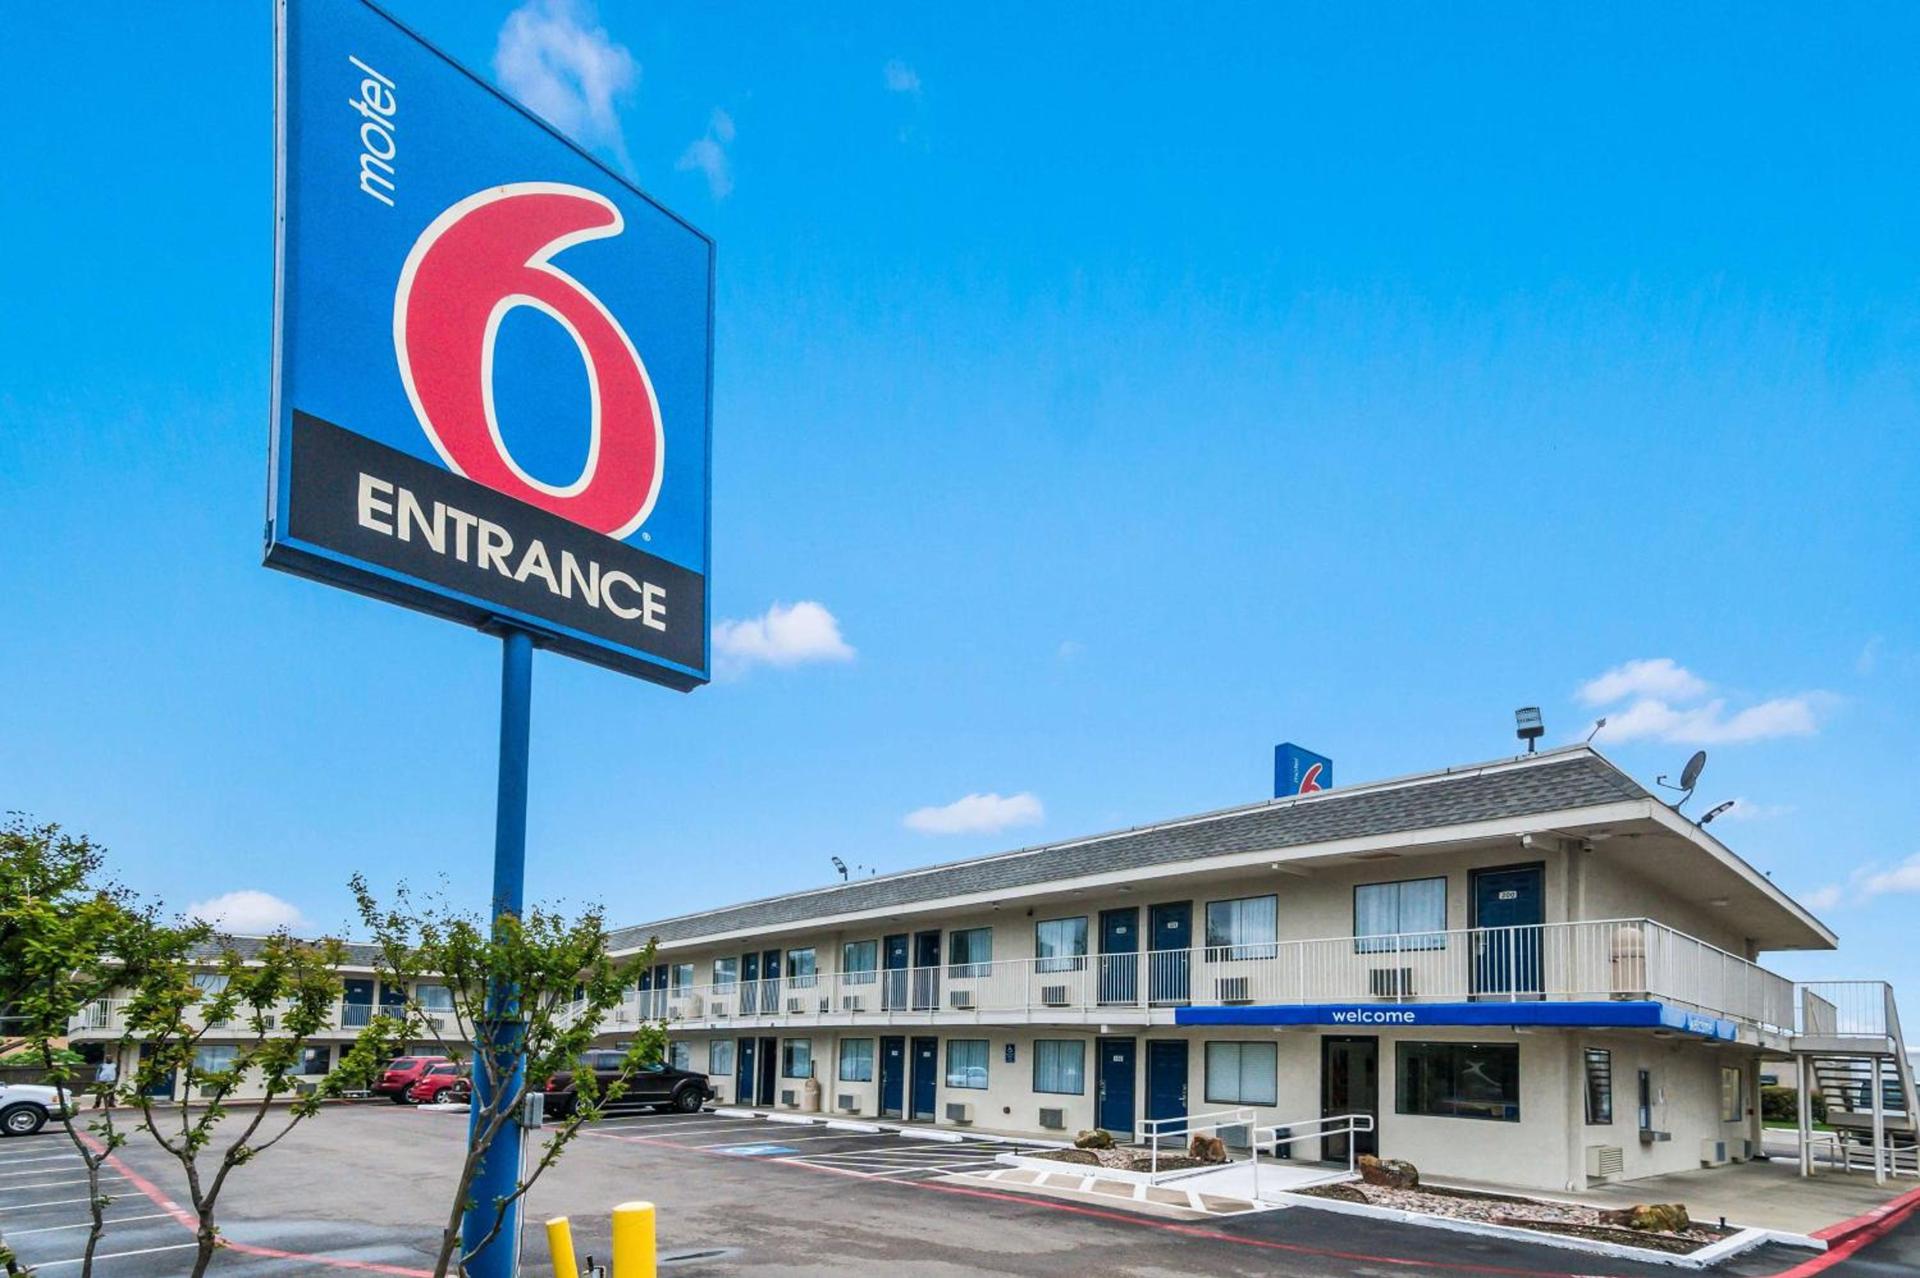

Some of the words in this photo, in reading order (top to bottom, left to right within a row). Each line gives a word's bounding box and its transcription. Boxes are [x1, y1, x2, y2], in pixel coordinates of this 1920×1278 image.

[348, 55, 397, 208] motel
[393, 181, 665, 541] 6
[357, 472, 667, 632] ENTRANCE
[1332, 1007, 1416, 1023] welcome
